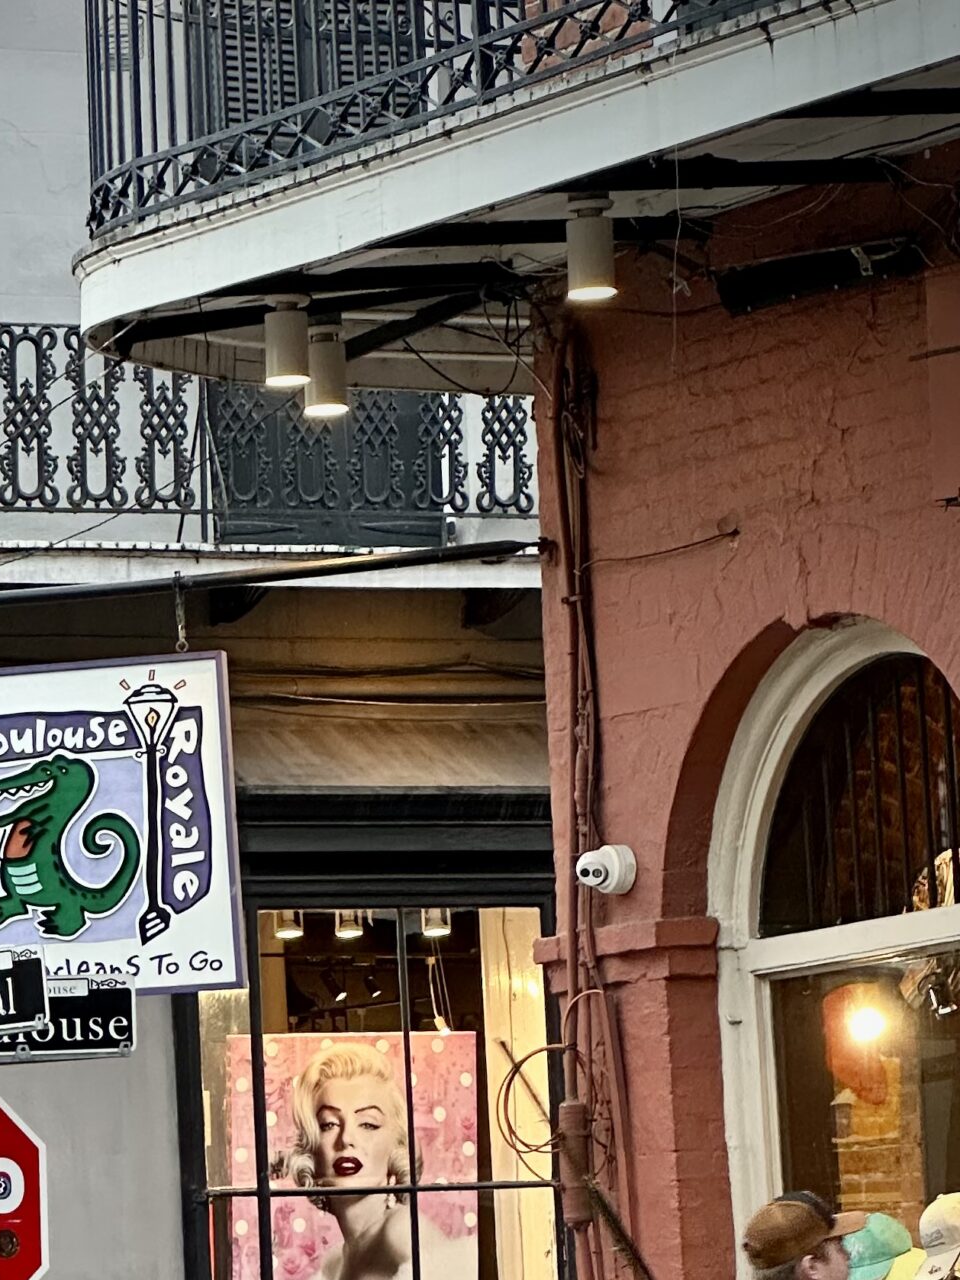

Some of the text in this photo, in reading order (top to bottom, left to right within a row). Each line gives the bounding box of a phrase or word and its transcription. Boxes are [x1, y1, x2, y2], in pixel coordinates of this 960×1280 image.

[164, 718, 205, 901] Royale
[149, 953, 180, 975] To
[189, 951, 223, 972] Go
